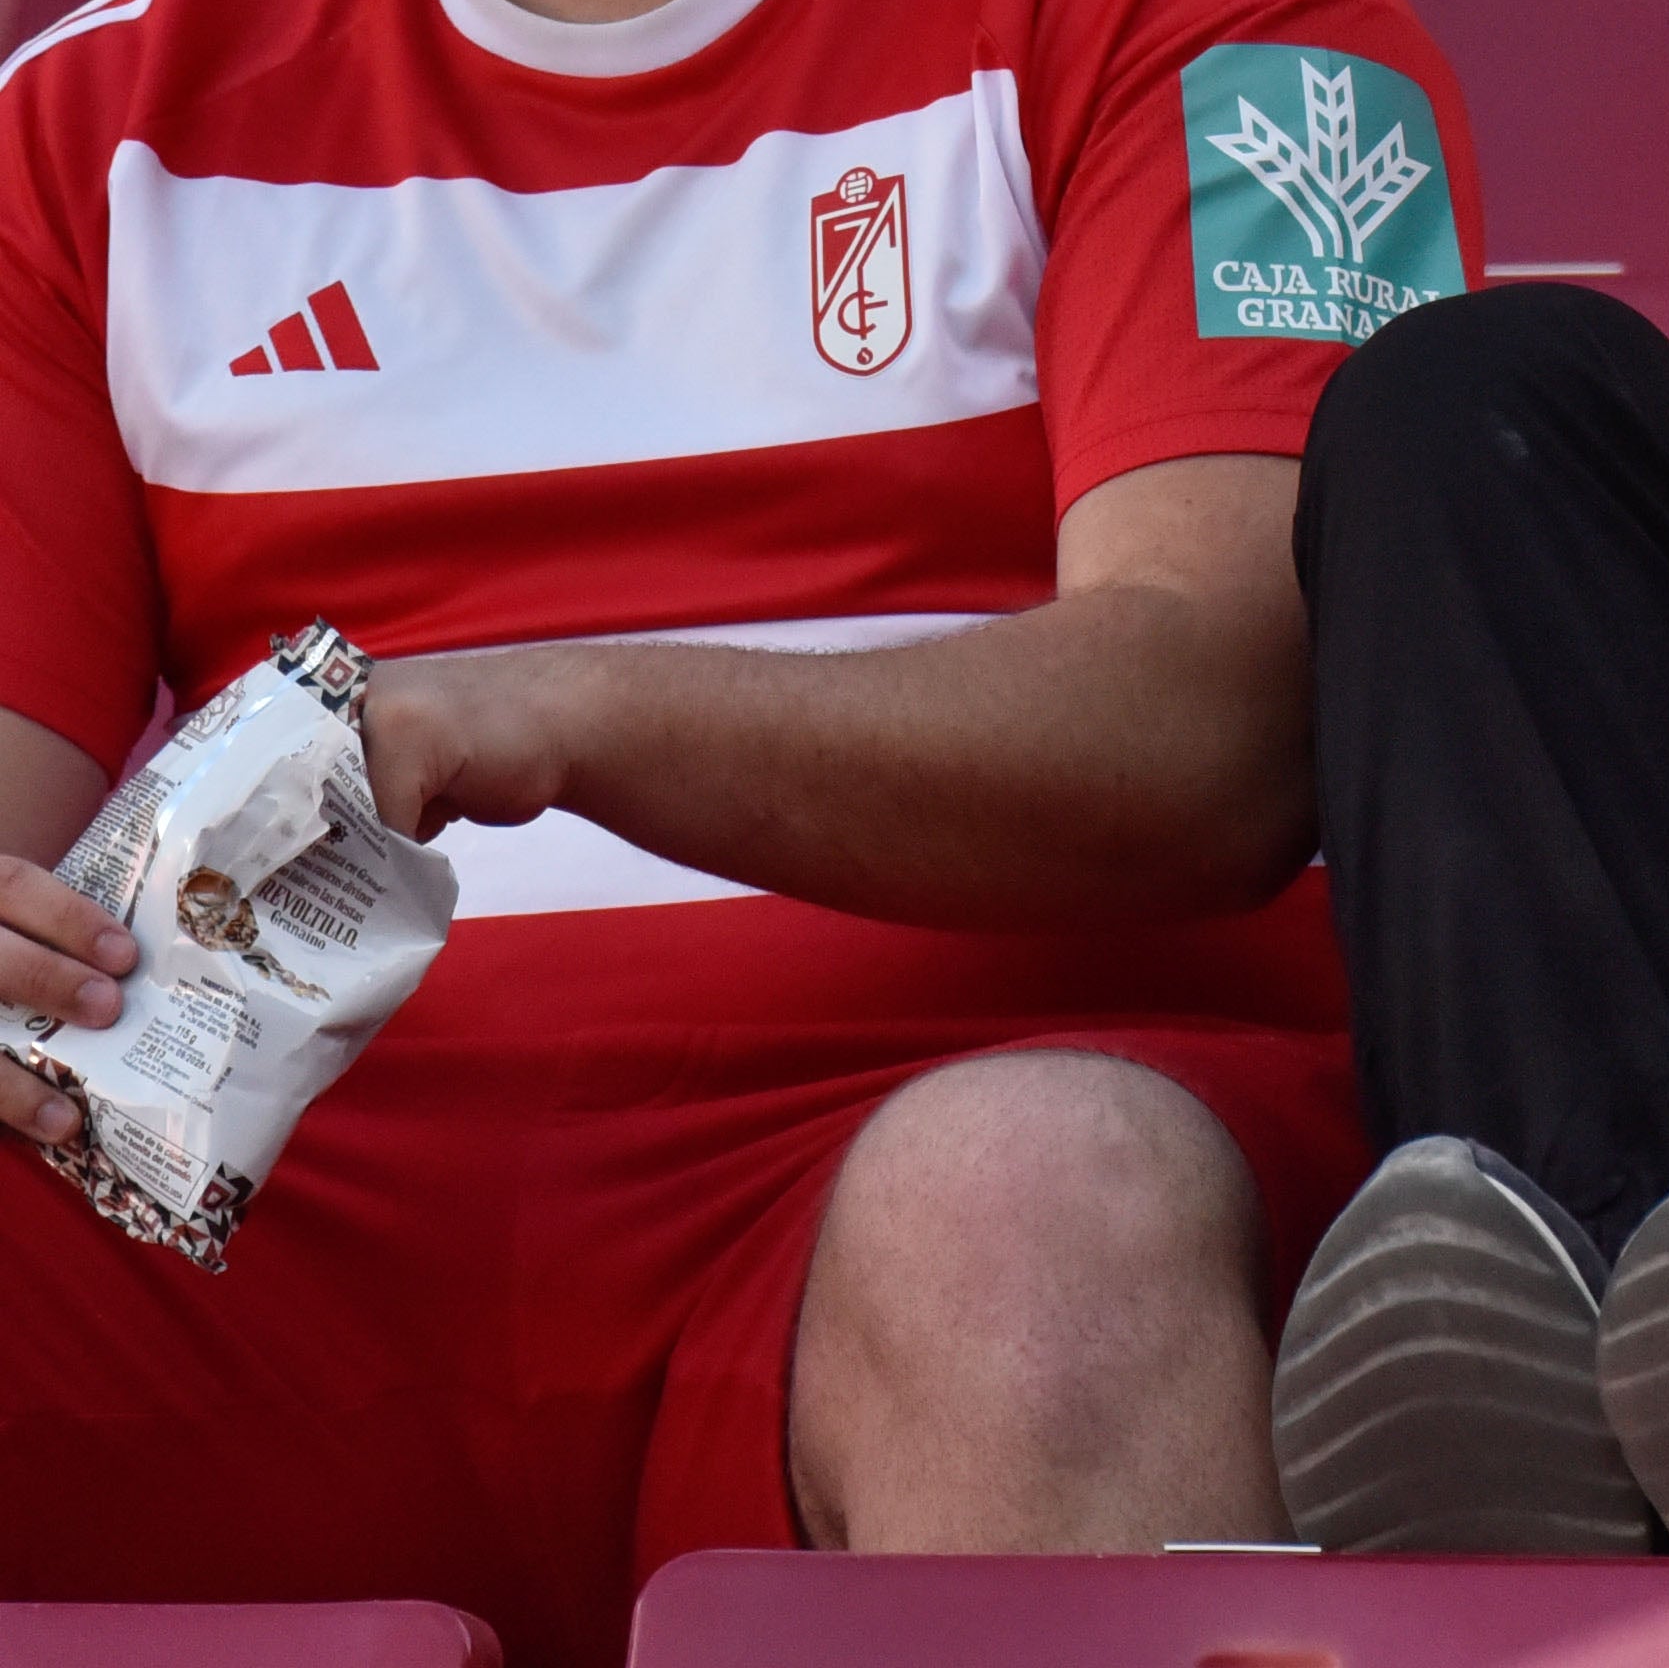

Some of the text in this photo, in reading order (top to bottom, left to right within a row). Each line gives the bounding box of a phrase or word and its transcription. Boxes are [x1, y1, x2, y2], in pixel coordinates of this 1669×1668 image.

[1212, 260, 1317, 297] CAJA
[1236, 298, 1393, 341] GRANA
[319, 887, 336, 907] las
[334, 897, 366, 925] fiestas
[176, 1024, 192, 1040] 115
[145, 1136, 156, 1148] de
[152, 1153, 165, 1167] del
